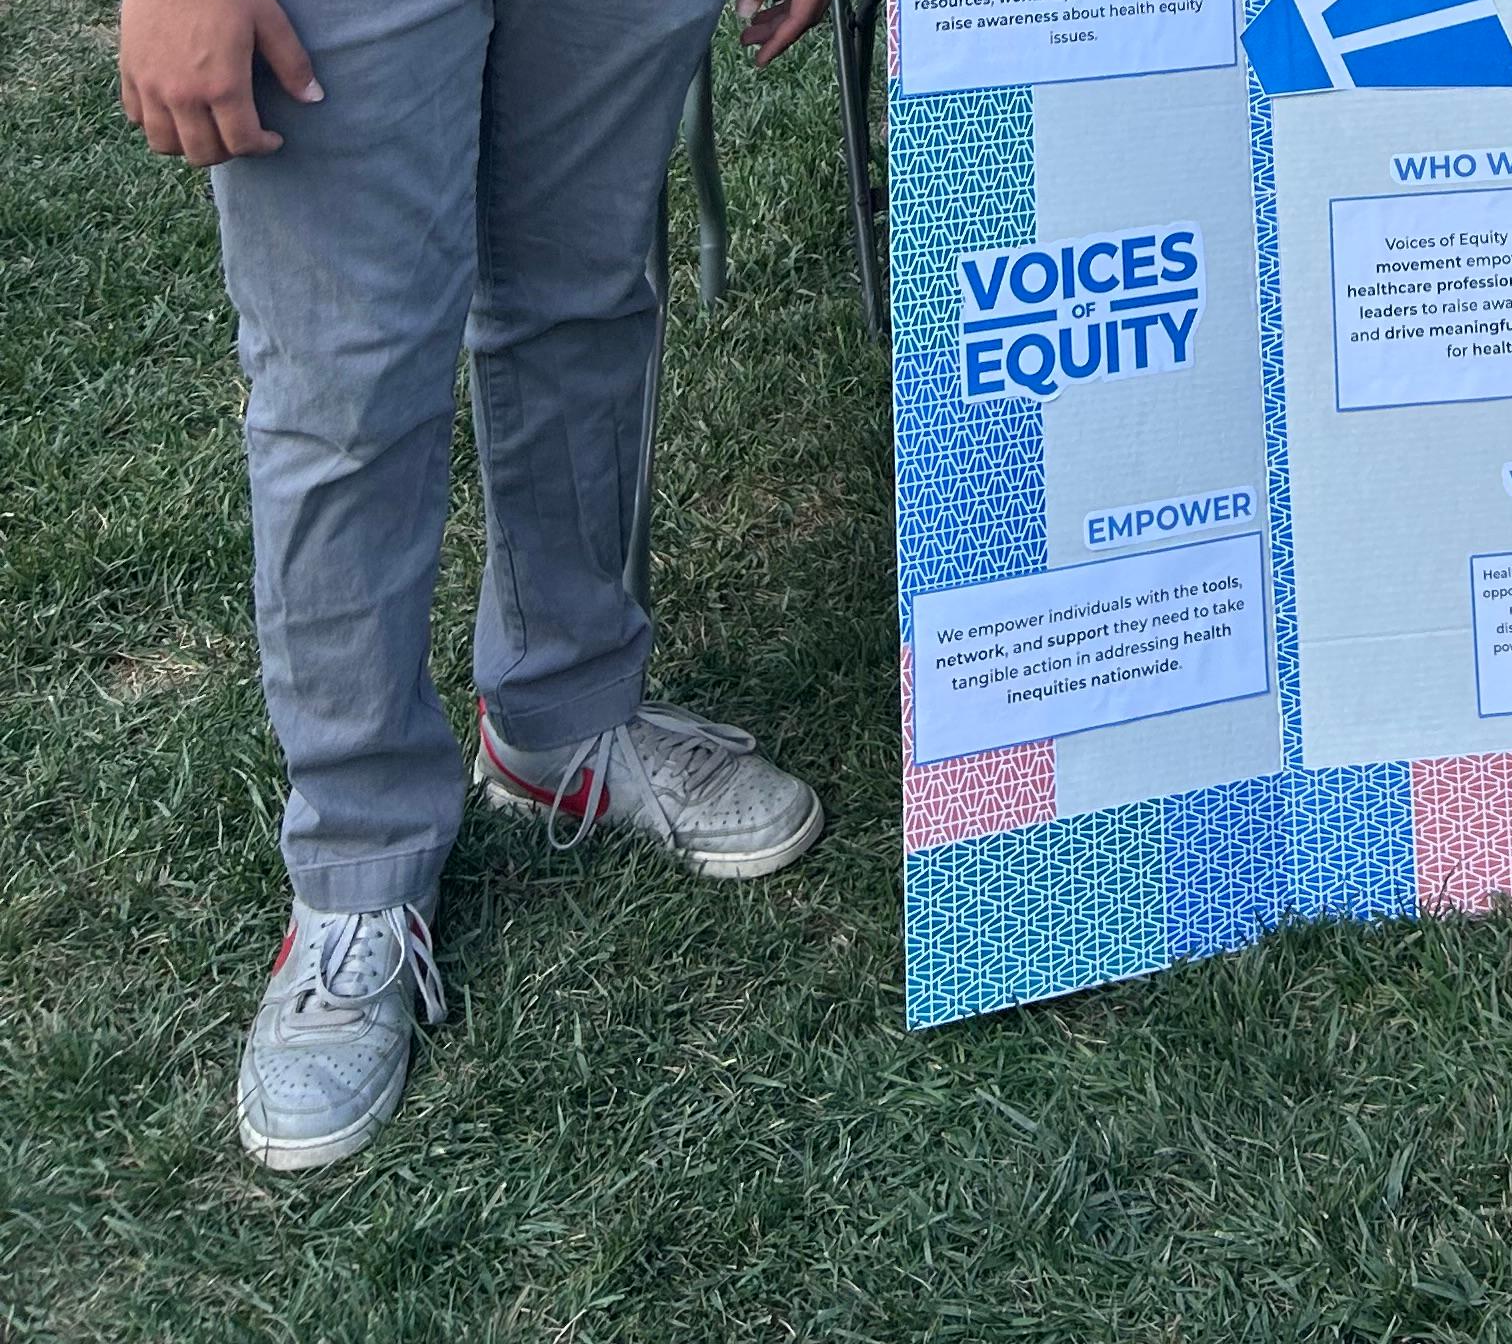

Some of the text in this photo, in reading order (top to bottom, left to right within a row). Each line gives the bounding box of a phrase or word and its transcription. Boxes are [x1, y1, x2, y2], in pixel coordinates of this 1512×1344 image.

[935, 15, 973, 32] raise
[976, 11, 1059, 29] awareness
[1062, 6, 1106, 21] about
[1109, 0, 1155, 18] health
[1050, 30, 1098, 45] issues.
[1393, 153, 1477, 181] WHO
[1384, 236, 1436, 251] Voices
[1439, 232, 1456, 247] of
[1459, 229, 1509, 248] Equity
[961, 231, 1198, 311] VOICES
[1376, 255, 1462, 274] movement
[1347, 281, 1432, 298] healthcare
[1072, 301, 1096, 318] OF
[1359, 303, 1418, 320] leaders
[1421, 303, 1438, 315] to
[1442, 298, 1478, 314] raise
[1350, 327, 1380, 343] and
[1384, 324, 1425, 340] drive
[966, 308, 1199, 400] EQUITY
[1447, 343, 1469, 358] for
[1088, 492, 1252, 545] EMPOWER
[936, 575, 1243, 645] We empower individuals with the tools,
[936, 598, 1245, 670] network, and support they need to take
[951, 622, 1232, 691] tangible action in addressing health
[1007, 657, 1182, 704] inequities nationwide.
